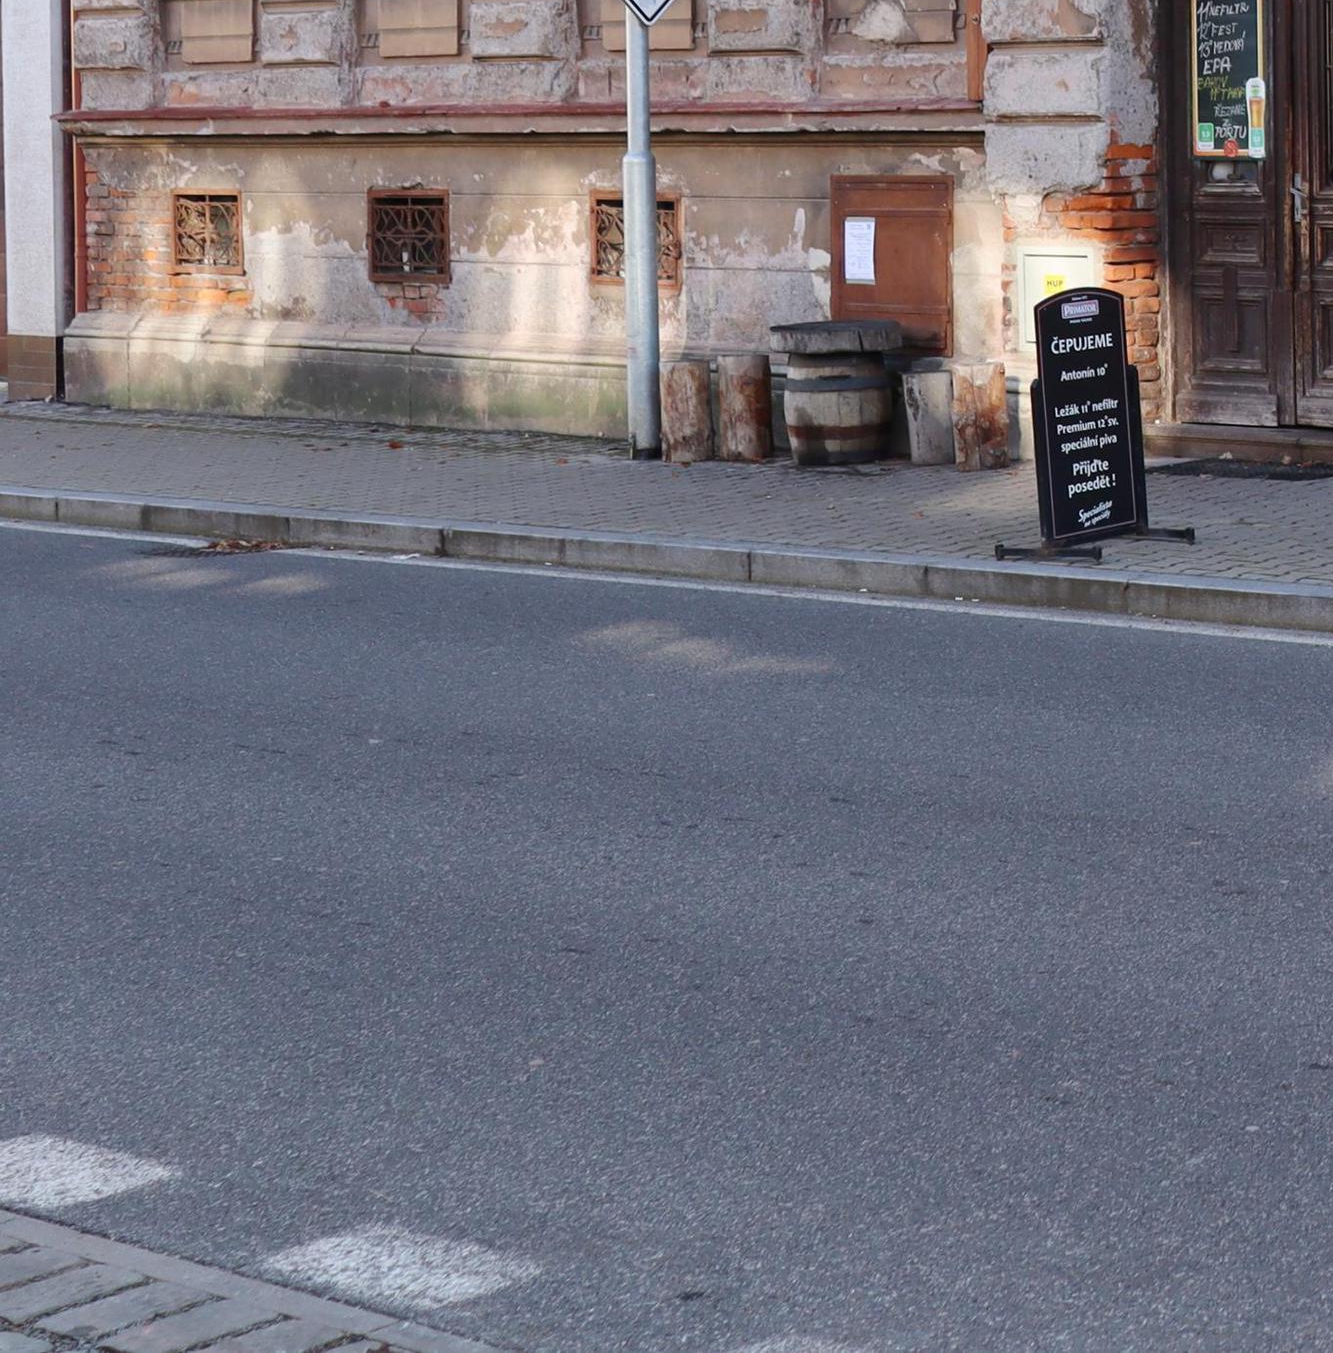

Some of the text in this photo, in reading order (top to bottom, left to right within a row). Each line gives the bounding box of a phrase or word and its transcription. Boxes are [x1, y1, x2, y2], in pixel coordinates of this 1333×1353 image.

[1211, 22, 1239, 37] FEST
[1203, 56, 1232, 76] EPA
[1215, 125, 1247, 140] PORTU
[1046, 279, 1064, 288] HUP
[1050, 332, 1114, 355] ČEPUJEME
[1060, 366, 1096, 382] Antonín
[1054, 403, 1080, 418] Ležák
[1091, 397, 1119, 412] nefiltr
[1056, 420, 1096, 435] Premium
[1060, 433, 1118, 455] speciální piva
